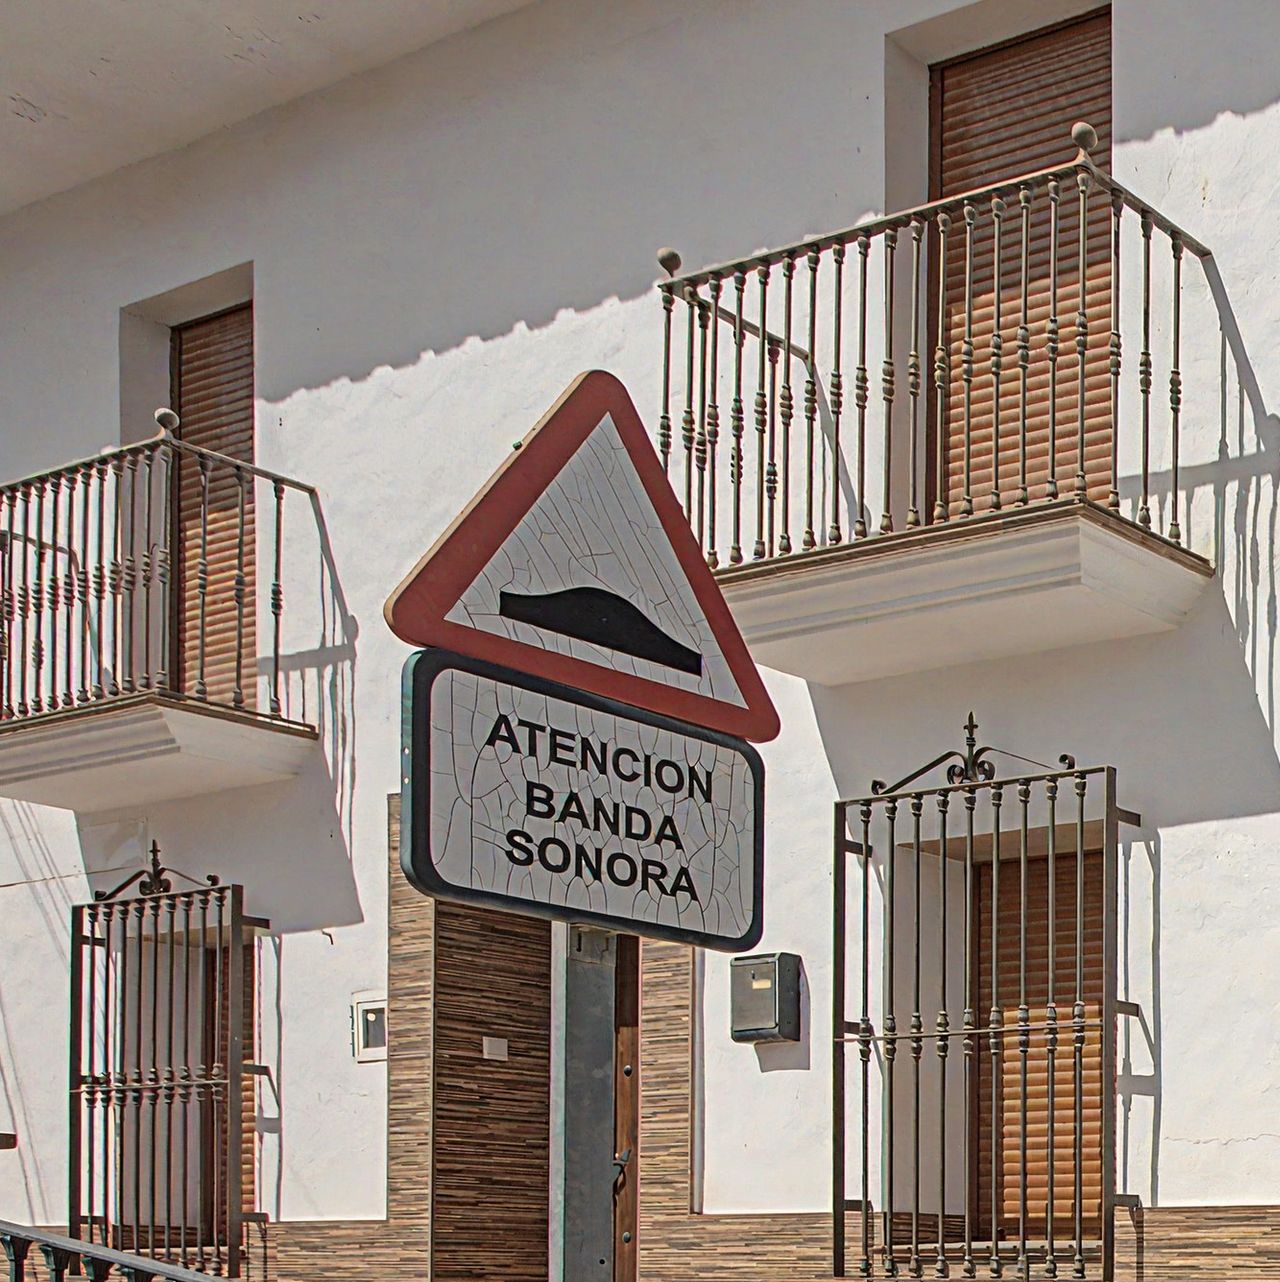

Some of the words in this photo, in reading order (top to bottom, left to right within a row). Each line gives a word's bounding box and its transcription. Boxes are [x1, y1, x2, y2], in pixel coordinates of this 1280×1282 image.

[486, 713, 713, 803] ATENCION
[526, 781, 684, 851] BANDA
[505, 829, 699, 902] SONORA
